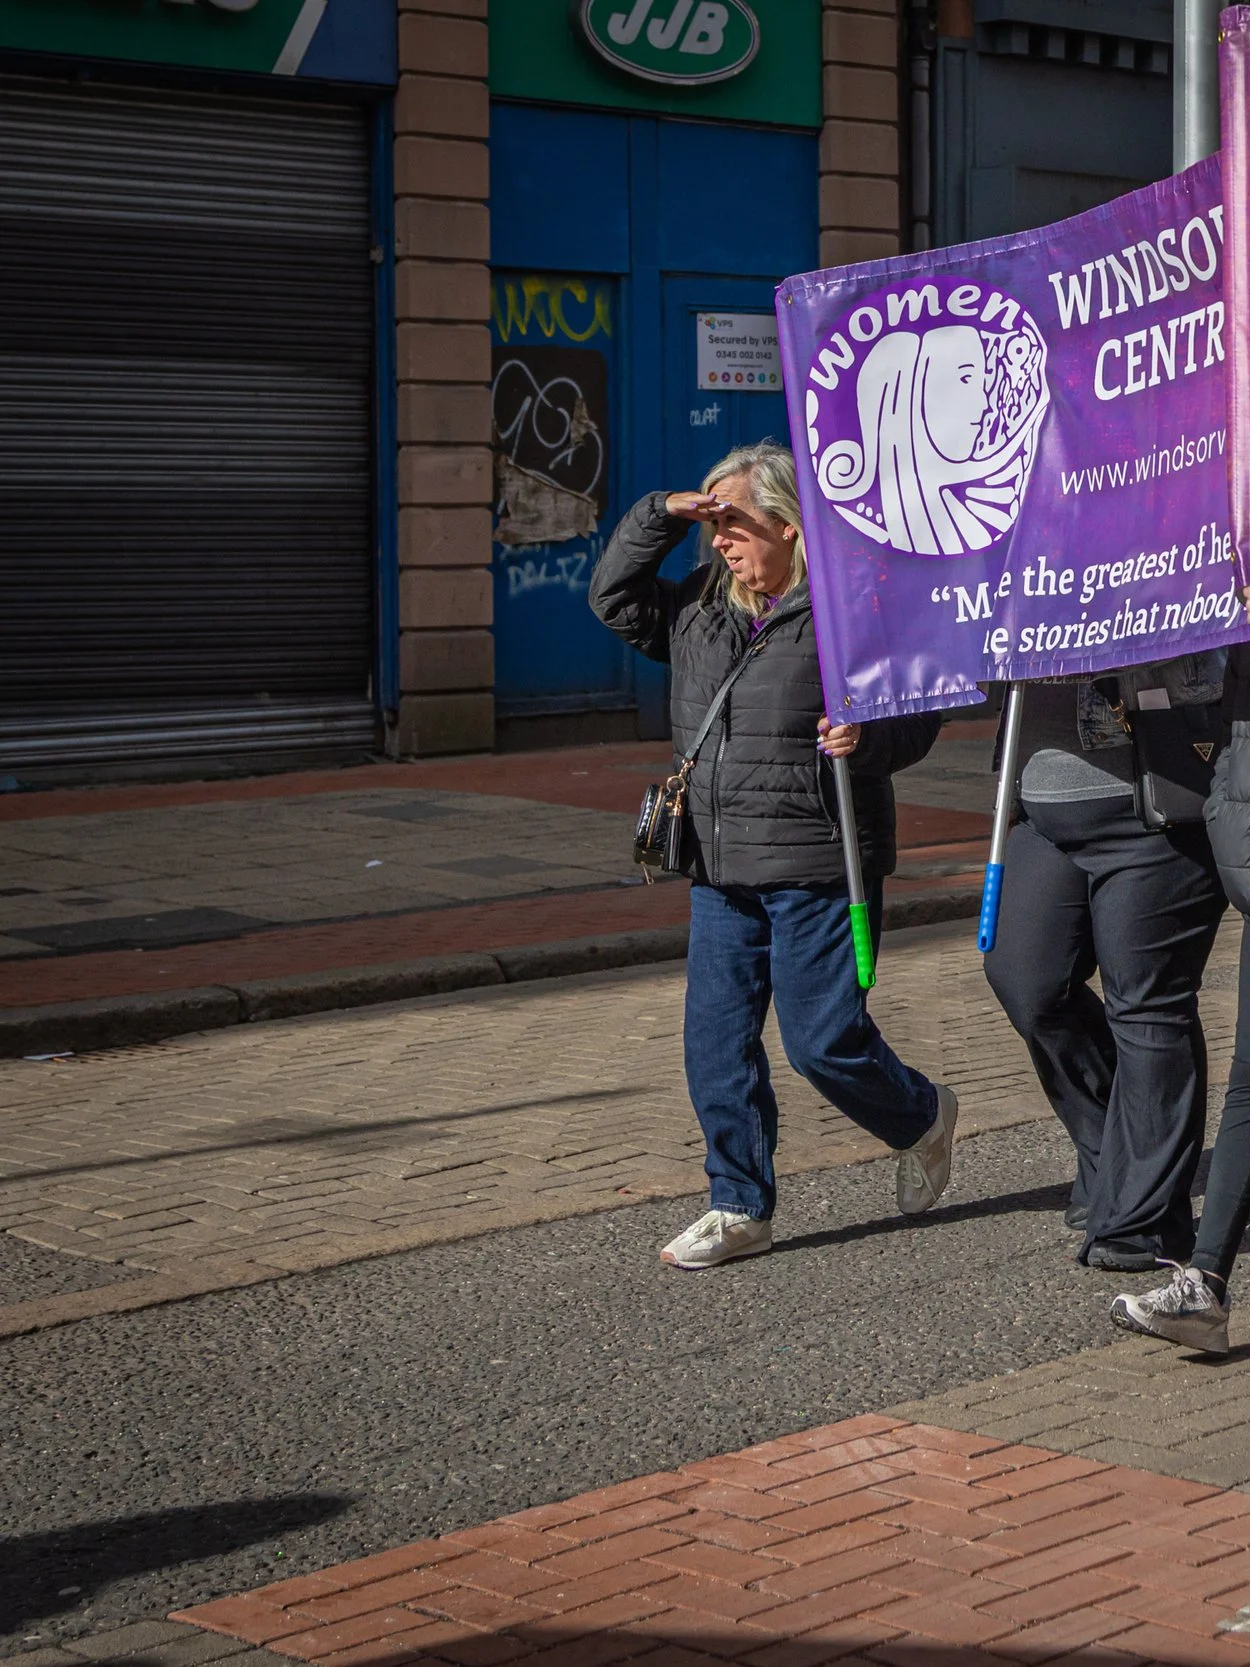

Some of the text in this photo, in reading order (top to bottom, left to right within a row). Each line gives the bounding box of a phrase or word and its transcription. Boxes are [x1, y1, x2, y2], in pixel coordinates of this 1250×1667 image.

[607, 0, 729, 55] JJB
[708, 334, 778, 347] Secured by VPS
[717, 320, 733, 328] VPS
[809, 284, 1021, 391] women
[716, 351, 737, 359] 0345
[1022, 556, 1074, 597] the
[1080, 544, 1178, 604] greatest
[1183, 525, 1208, 573] of
[1018, 611, 1110, 654] stories
[1112, 599, 1160, 639] that
